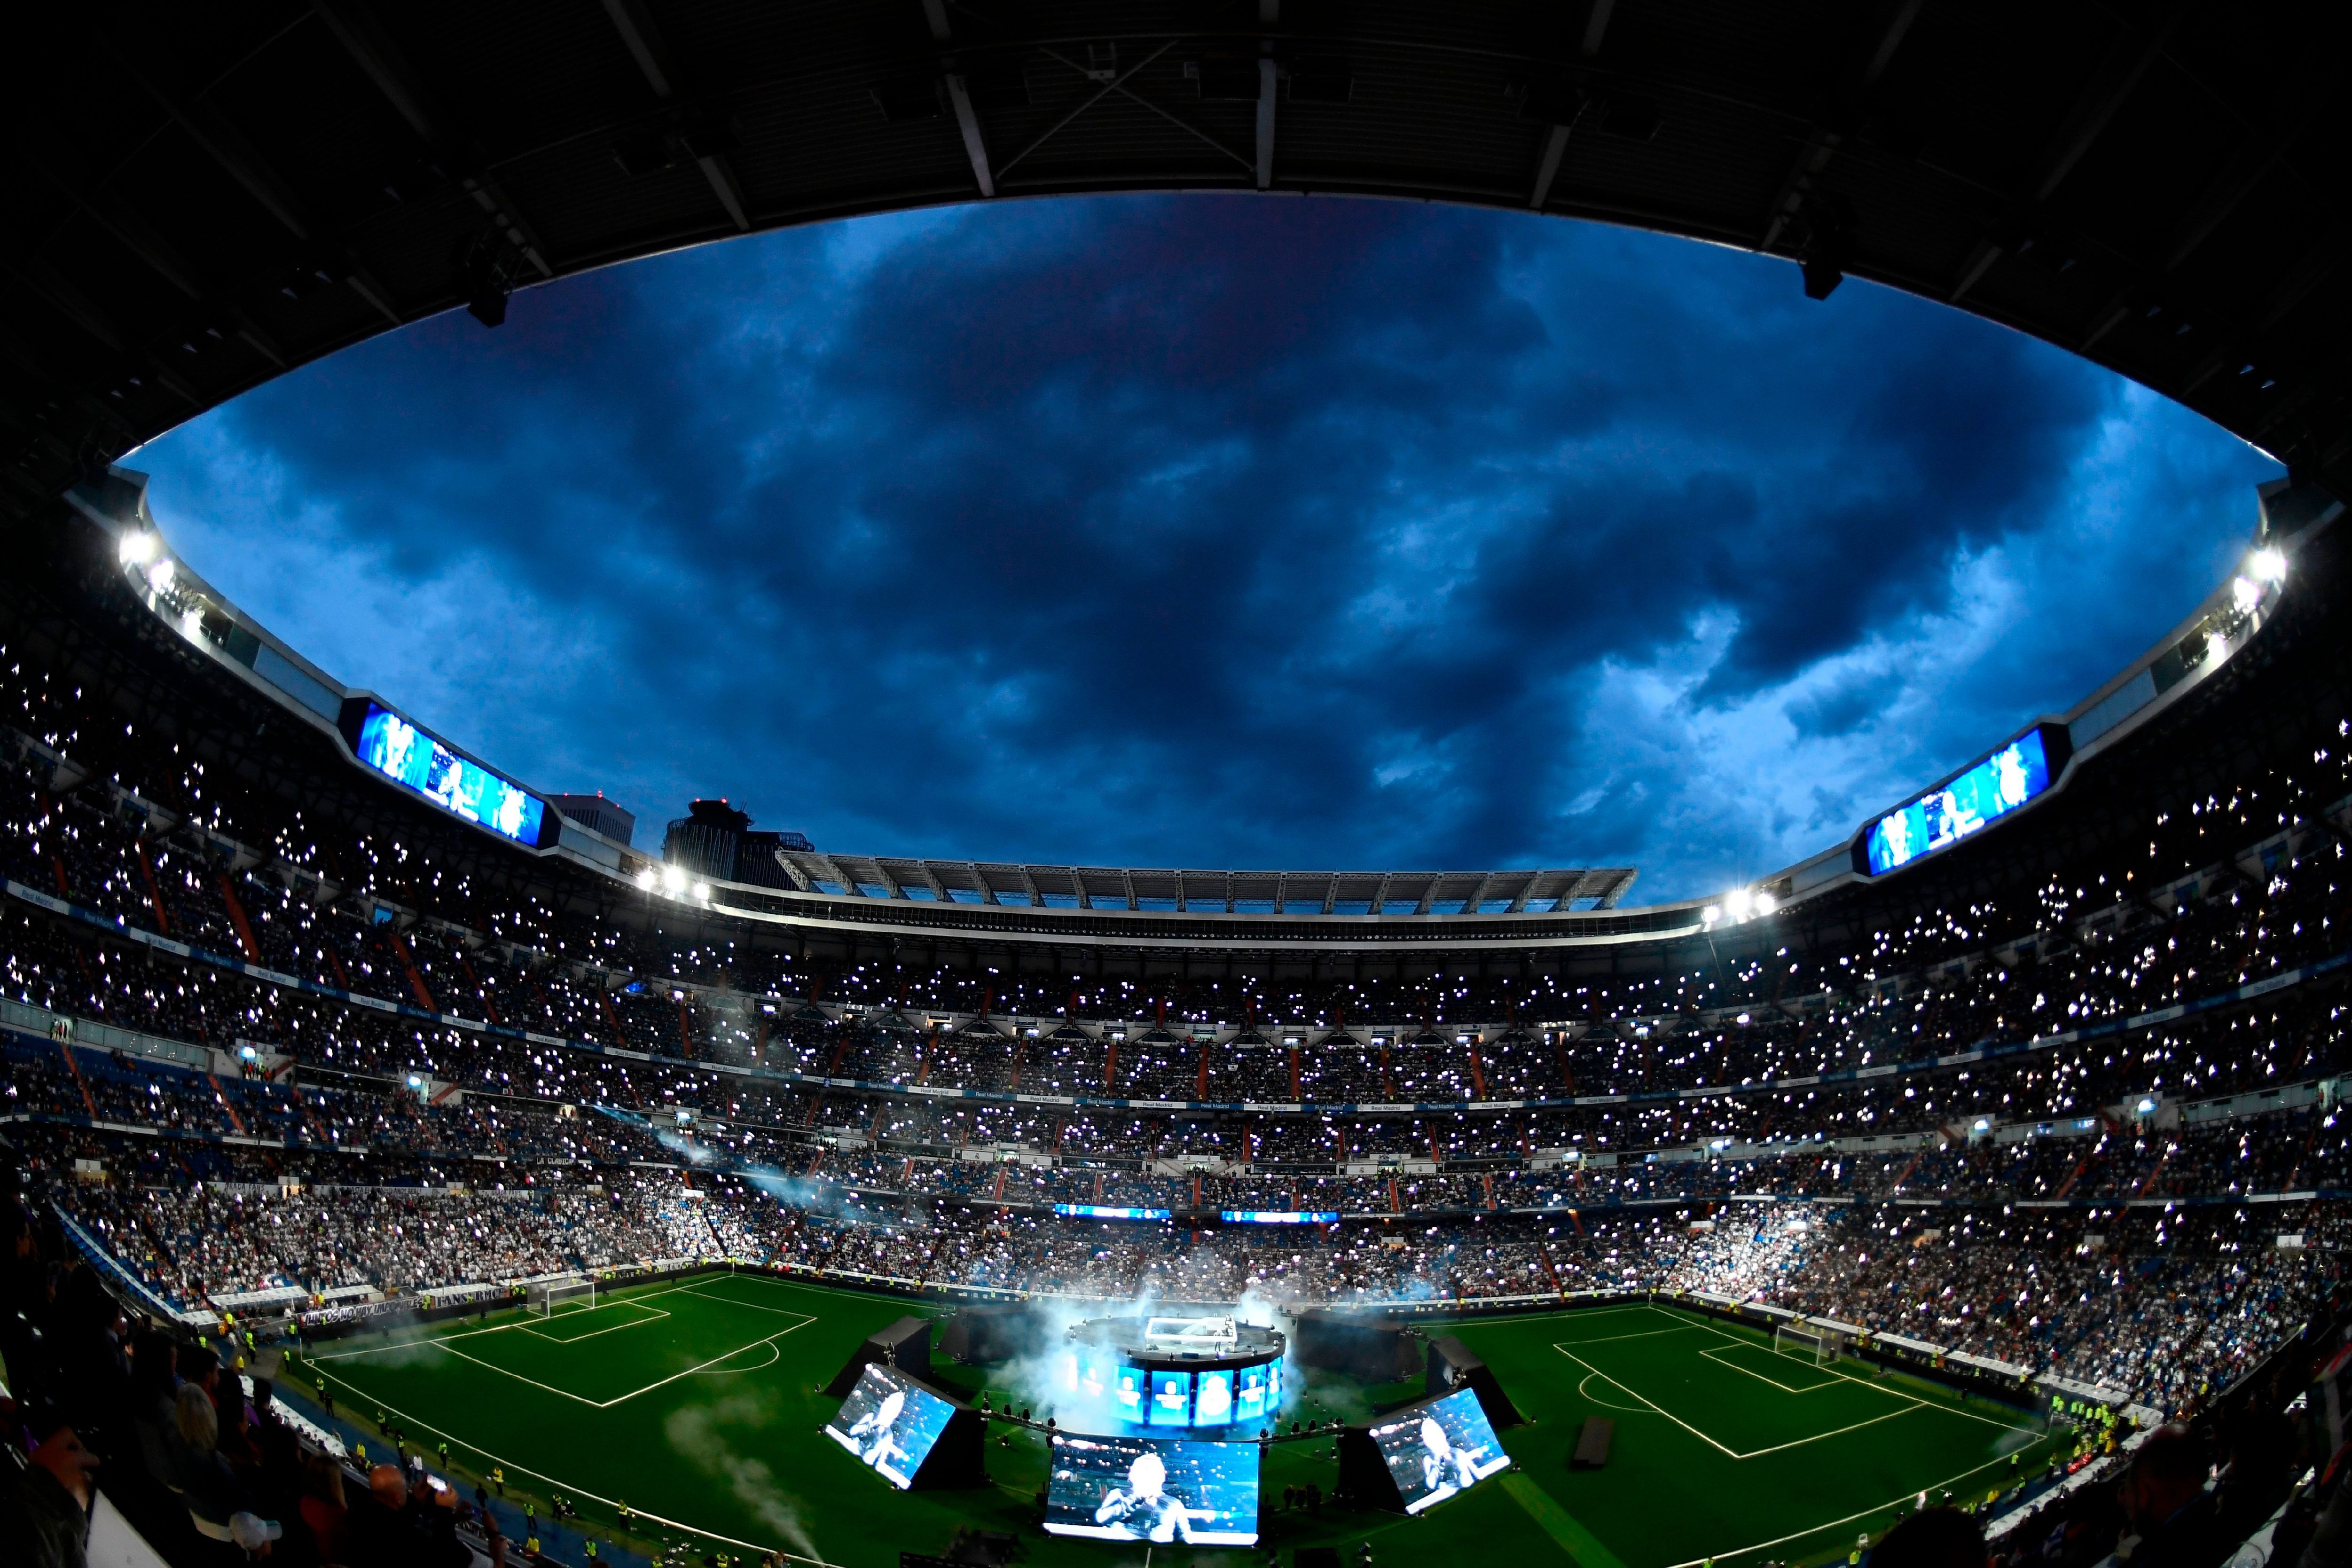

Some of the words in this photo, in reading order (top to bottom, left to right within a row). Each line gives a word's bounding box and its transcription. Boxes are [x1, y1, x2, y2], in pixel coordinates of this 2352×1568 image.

[437, 1293, 467, 1307] FANS
[340, 1307, 354, 1322] NO
[355, 1304, 372, 1318] HAY
